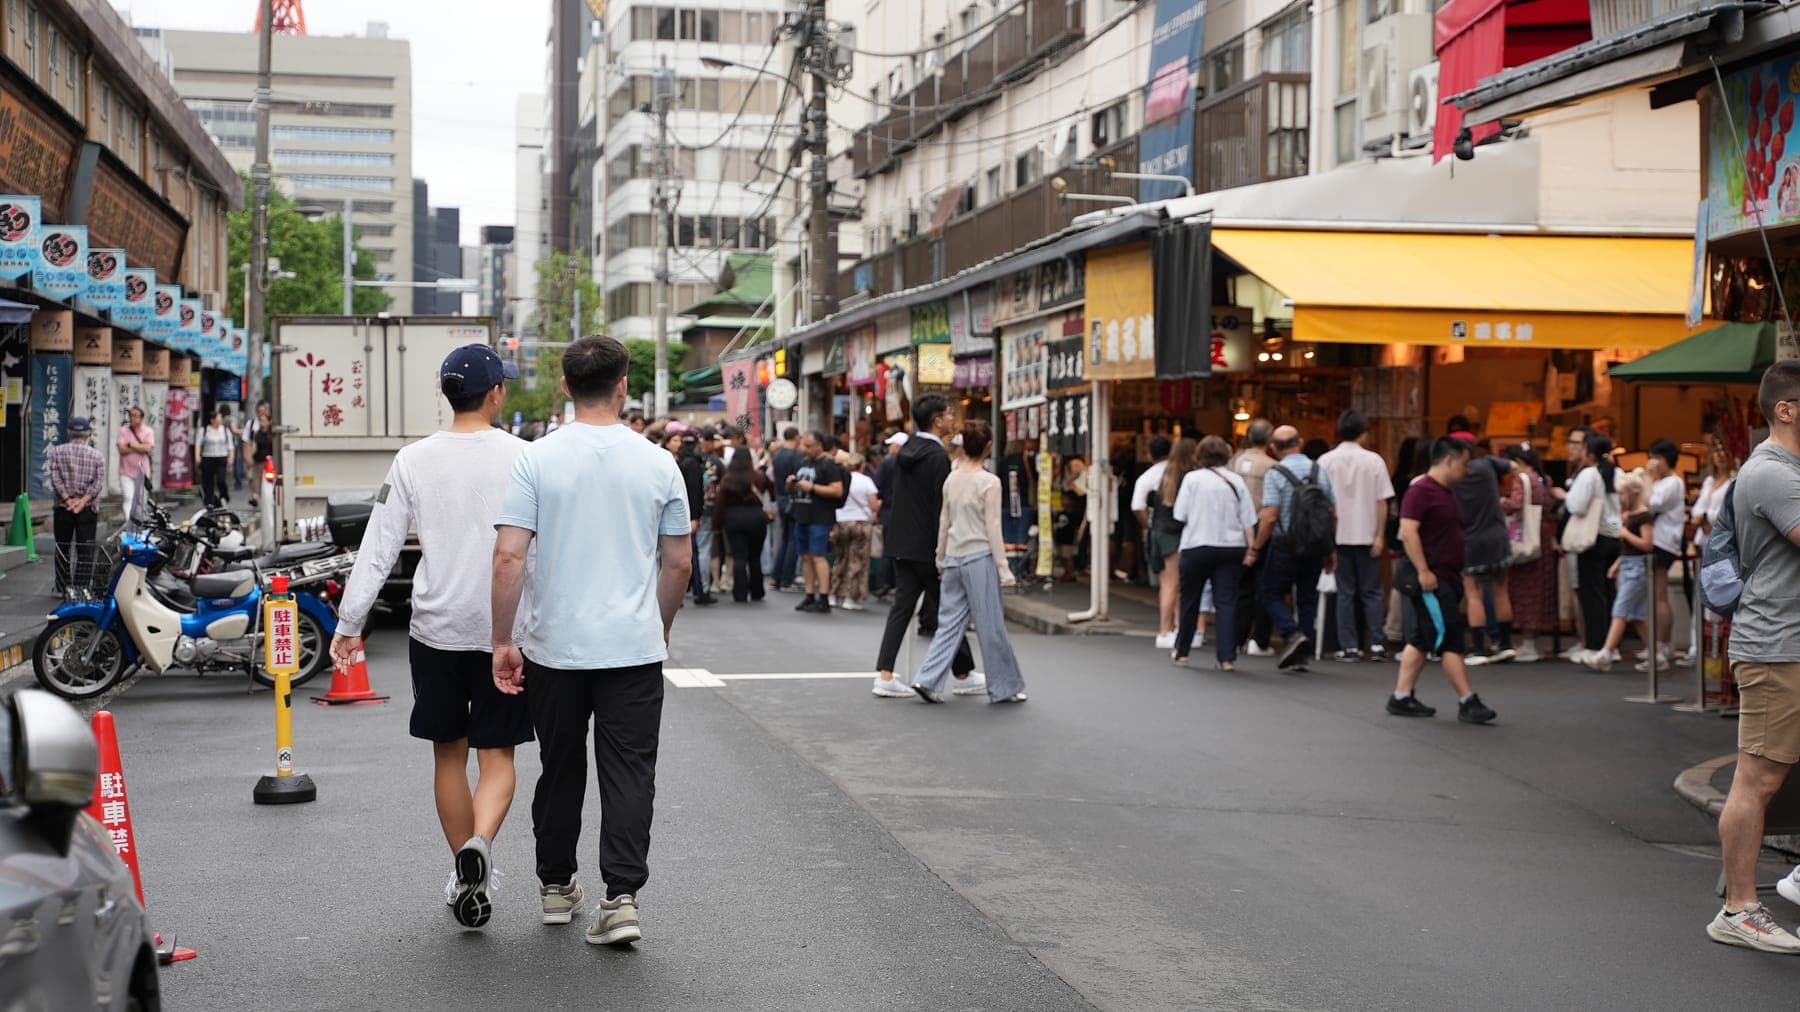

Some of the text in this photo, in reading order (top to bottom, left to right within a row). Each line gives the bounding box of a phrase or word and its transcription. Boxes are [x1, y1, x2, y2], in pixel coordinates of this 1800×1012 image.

[321, 372, 344, 427] 松露
[274, 610, 292, 665] 駐車禁止
[100, 771, 129, 867] 駐車禁
